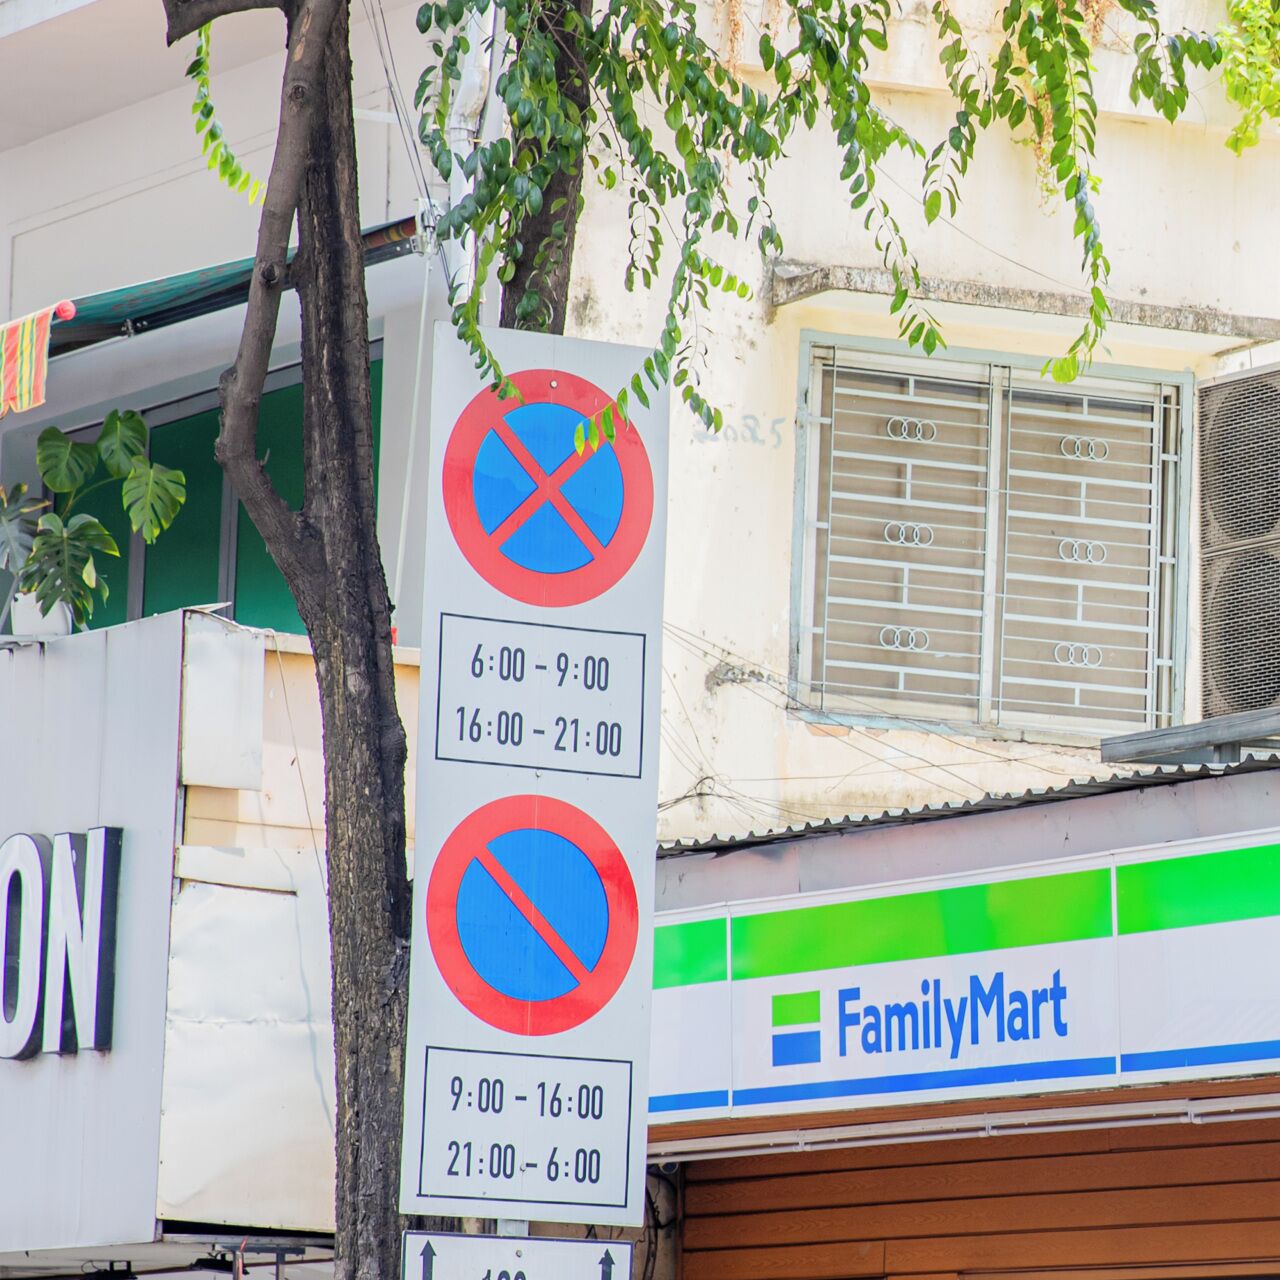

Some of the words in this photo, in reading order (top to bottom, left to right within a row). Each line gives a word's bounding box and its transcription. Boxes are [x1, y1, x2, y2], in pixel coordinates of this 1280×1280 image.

[471, 643, 525, 682] 6:00
[556, 652, 609, 691] 9:00
[456, 706, 523, 746] 16:00
[554, 716, 622, 756] 21:00
[838, 968, 1068, 1059] FamilyMart
[450, 1076, 504, 1114] 9:00
[537, 1081, 603, 1120] 16:00
[447, 1141, 515, 1179] 21:00
[547, 1147, 601, 1184] 6:00
